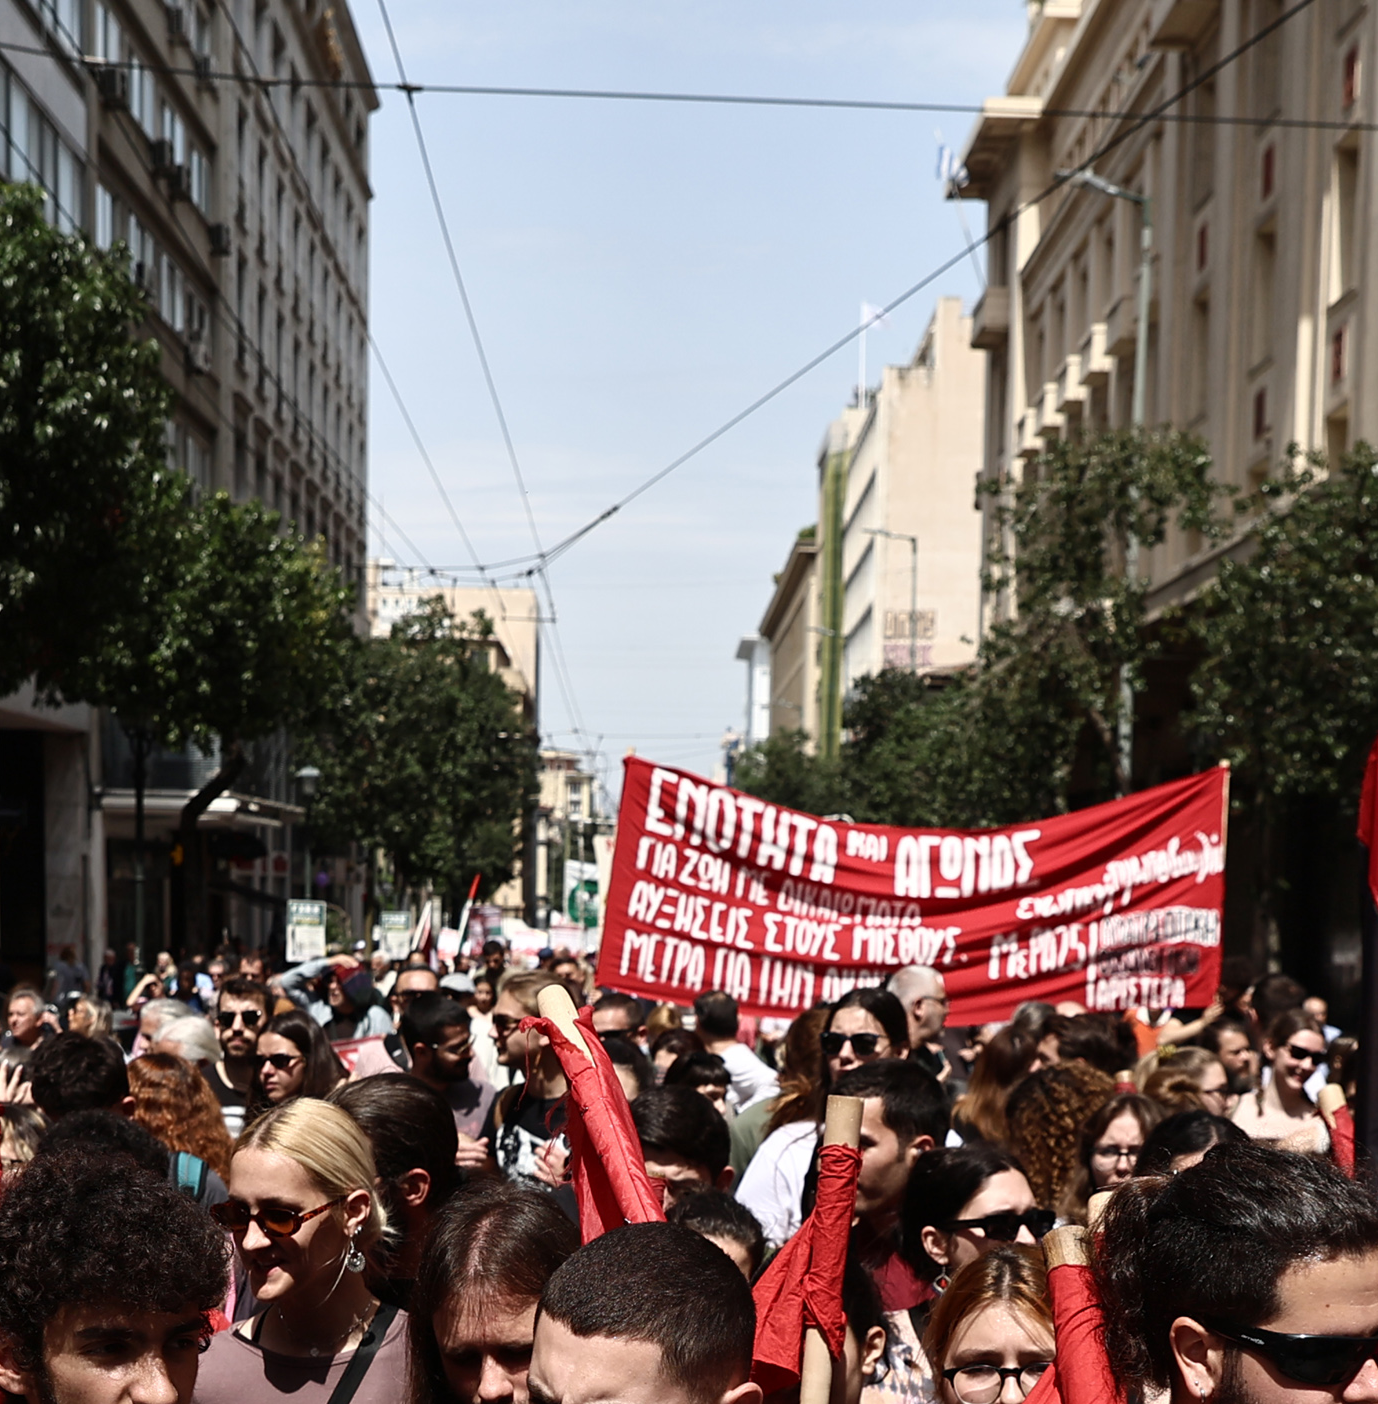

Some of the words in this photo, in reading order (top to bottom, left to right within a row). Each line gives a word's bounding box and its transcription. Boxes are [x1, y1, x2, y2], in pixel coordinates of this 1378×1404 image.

[636, 836, 677, 880] ΓΙΑ
[678, 848, 731, 895] ΖΩΗ
[645, 767, 838, 884] ΕΝΟΤΗΤΑ
[846, 830, 888, 863] ΚΑΙ
[894, 829, 1041, 898] ΑΓΩΝΑΣ
[628, 880, 754, 951] ΑΥΞΗΣΕΙΣ
[763, 912, 843, 961] ΣΤΟΥΣ
[620, 929, 705, 992] ΜΕΤΡΑ
[713, 947, 751, 1002] ΓΙΑ
[759, 955, 815, 1009] ΤΗΝ
